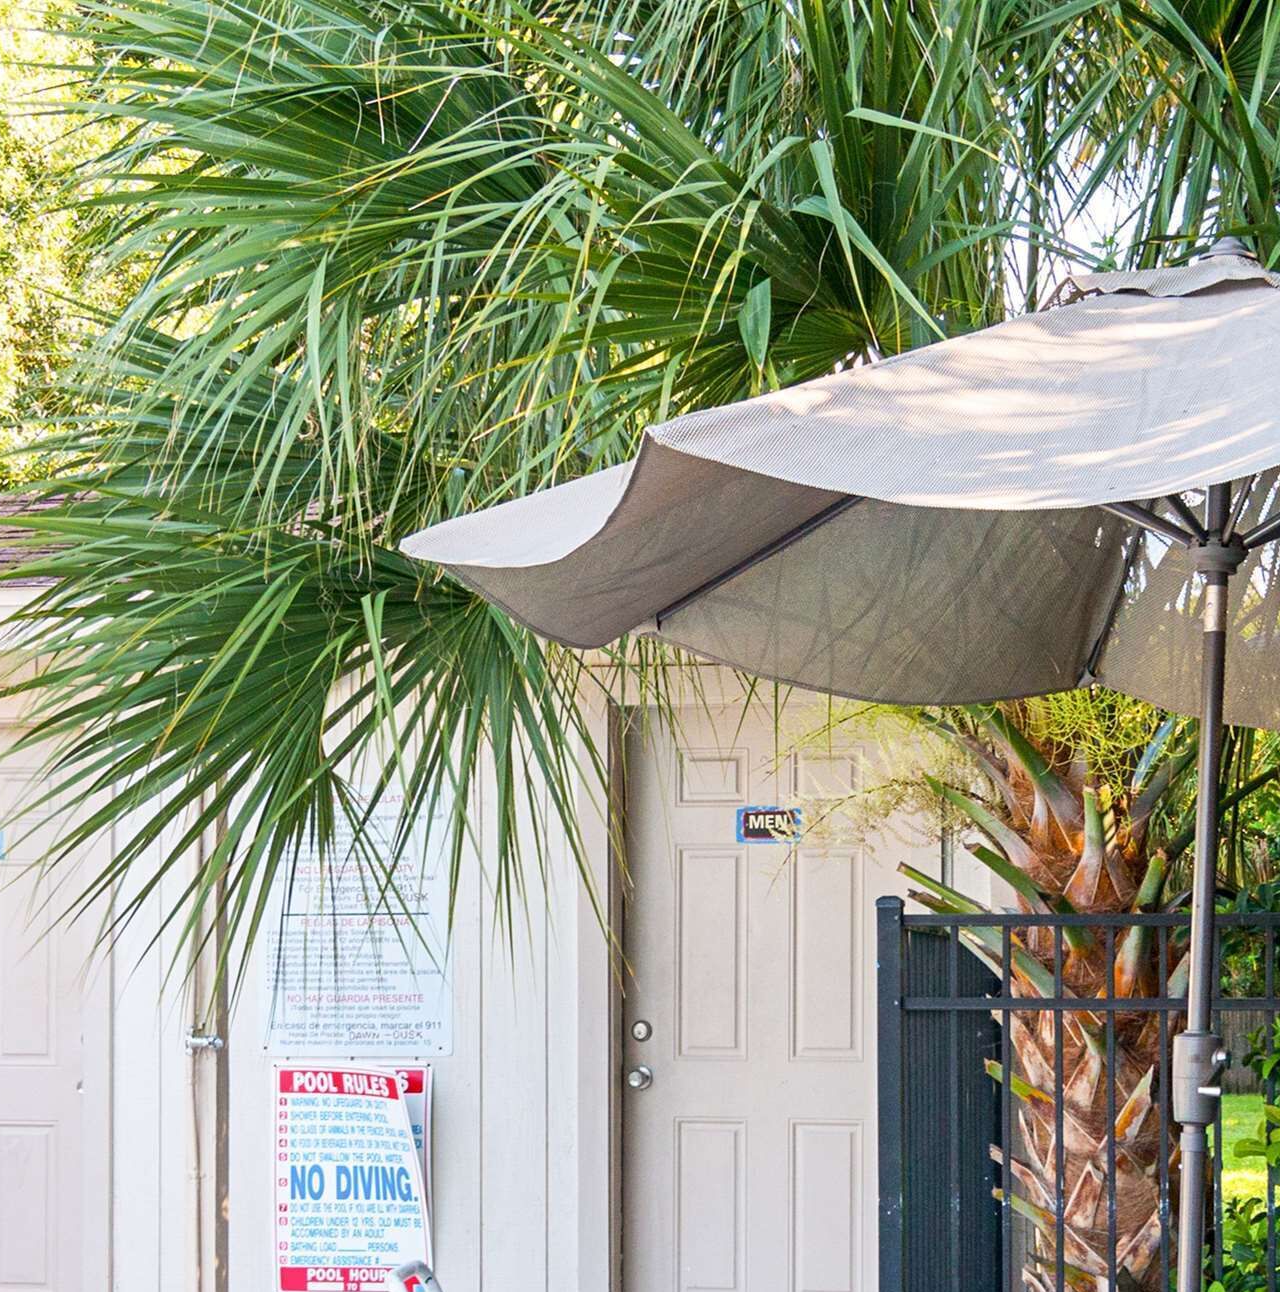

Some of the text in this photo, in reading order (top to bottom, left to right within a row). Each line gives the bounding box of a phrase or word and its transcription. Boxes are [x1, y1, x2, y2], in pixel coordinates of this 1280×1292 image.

[748, 814, 788, 829] MEN
[287, 994, 424, 1003] NO HAY GUARDIA PRESENTE
[308, 1021, 321, 1030] de
[322, 1022, 378, 1033] emergencia,
[425, 1020, 442, 1030] 911
[349, 1031, 380, 1040] DAWN
[393, 1030, 424, 1039] DUSK
[293, 1072, 338, 1093] POOL
[343, 1074, 389, 1097] RULES
[322, 1097, 332, 1107] NO
[291, 1111, 317, 1121] SHOWER
[320, 1111, 343, 1121] BEFORE
[345, 1111, 372, 1122] ENTERING
[290, 1152, 300, 1162] DO
[302, 1152, 316, 1162] NOT
[319, 1152, 350, 1163] SWALLOW
[352, 1152, 365, 1163] THE
[366, 1152, 384, 1163] POOL
[290, 1164, 325, 1201] NO
[335, 1165, 419, 1202] DIVING.
[290, 1216, 324, 1226] CHILDREN
[326, 1216, 349, 1226] UNDER
[378, 1216, 391, 1227] OLD
[393, 1217, 411, 1228] MUST
[413, 1218, 422, 1229] BE
[290, 1228, 338, 1238] ACCOMPANIED
[340, 1228, 350, 1238] BY
[352, 1228, 362, 1239] AN
[290, 1242, 317, 1252] BATHING
[290, 1255, 329, 1265] EMERGENCY
[332, 1255, 372, 1265] ASSISTANCE
[307, 1268, 344, 1281] POOL
[346, 1283, 358, 1291] TO
